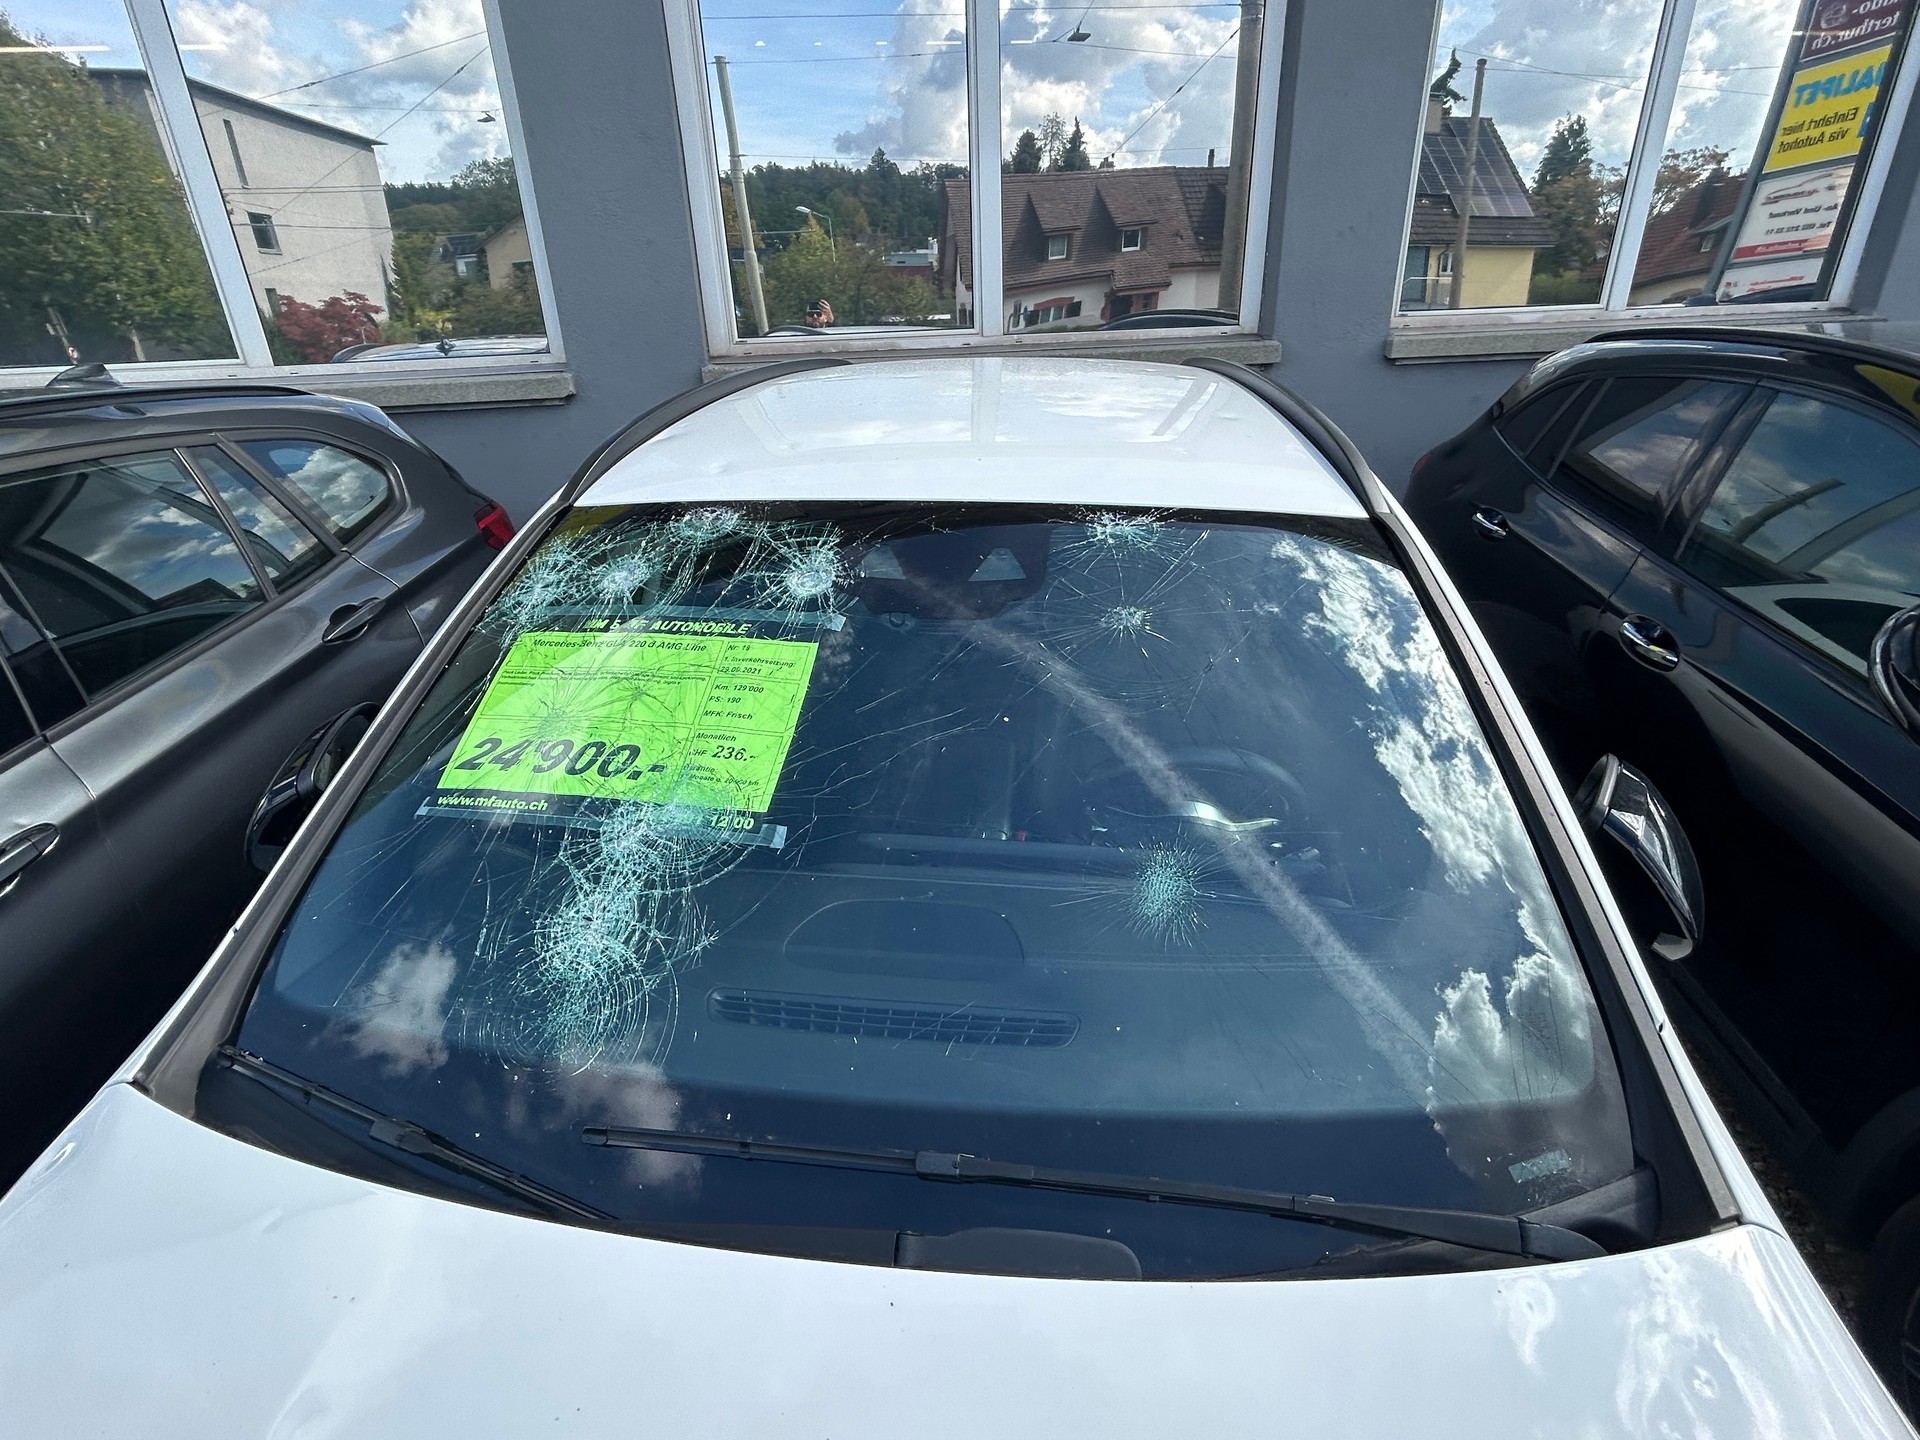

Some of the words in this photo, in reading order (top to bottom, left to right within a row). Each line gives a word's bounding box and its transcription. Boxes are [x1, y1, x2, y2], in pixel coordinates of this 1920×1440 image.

[650, 620, 753, 634] AUTOMOBILE
[532, 639, 606, 648] Mercedes-Benz
[629, 640, 646, 648] 220
[647, 640, 656, 648] d
[656, 641, 684, 651] AMG
[685, 643, 707, 652] Line
[714, 683, 730, 691] Km:
[733, 684, 764, 694] 129'000
[709, 695, 722, 703] PS:
[727, 696, 741, 704] 190
[703, 710, 725, 718] MFK:
[726, 711, 753, 720] Frisch
[696, 732, 737, 742] Monatlich
[454, 737, 666, 781] 24'900.-
[711, 745, 756, 762] 236.-
[437, 795, 549, 811] www.mfauto.ch
